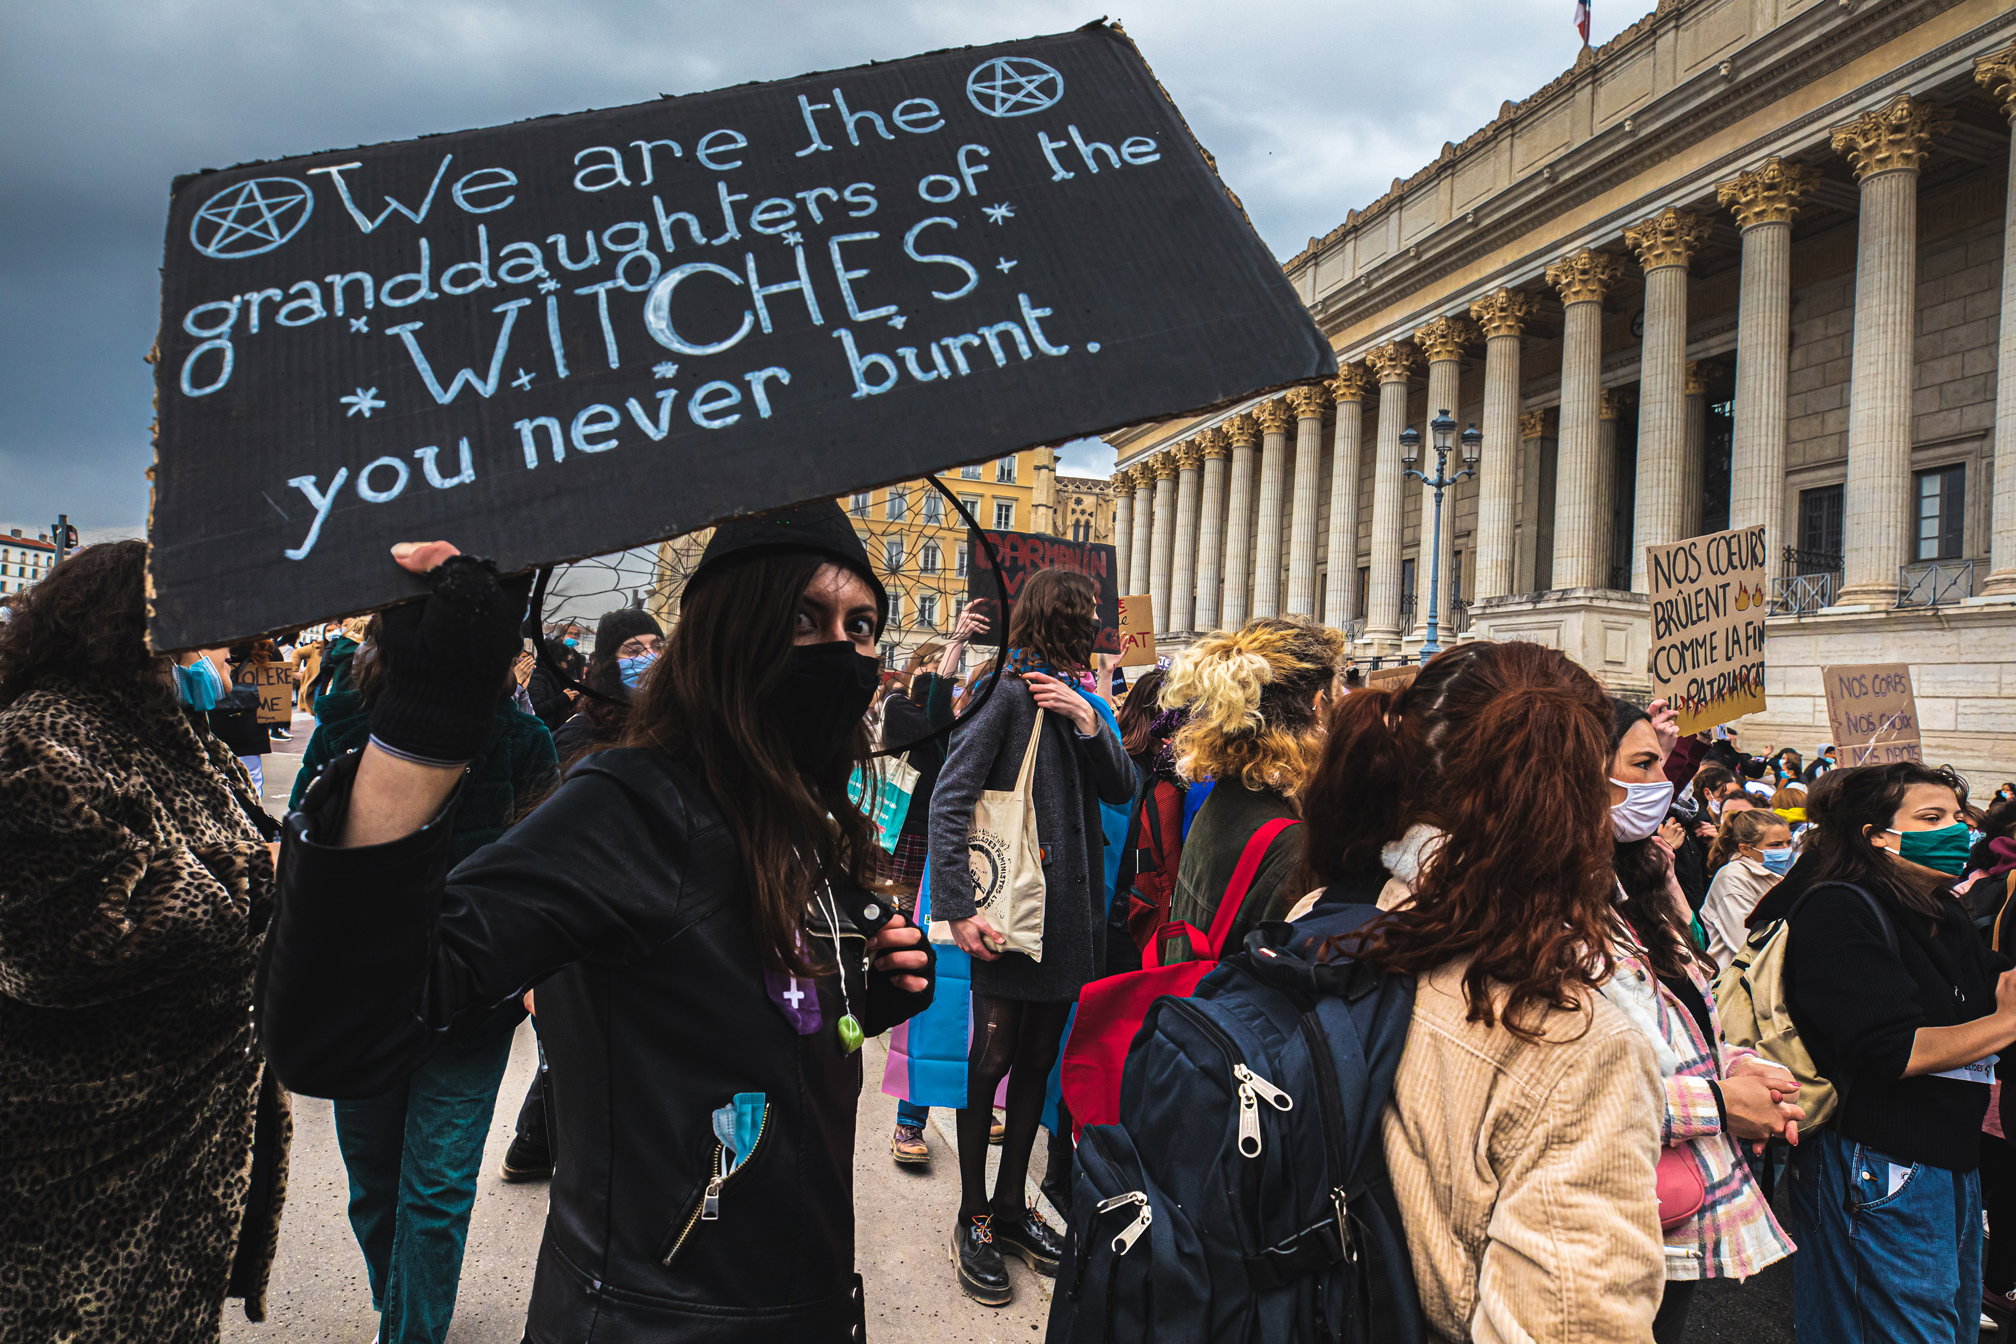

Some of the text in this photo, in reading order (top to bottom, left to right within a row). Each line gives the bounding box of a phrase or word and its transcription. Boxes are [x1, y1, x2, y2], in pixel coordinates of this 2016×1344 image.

[307, 88, 945, 233] We are the
[180, 124, 1160, 397] granddaughters of the
[285, 293, 1101, 560] you never burnt.
[1653, 541, 1702, 594] NOS
[1653, 620, 1765, 684] COMME LA FIN
[1686, 660, 1766, 719] PATRIARCAT
[1837, 672, 1907, 700] NOS CORPS
[1845, 711, 1877, 736] NOS
[1852, 746, 1881, 765] NOS
